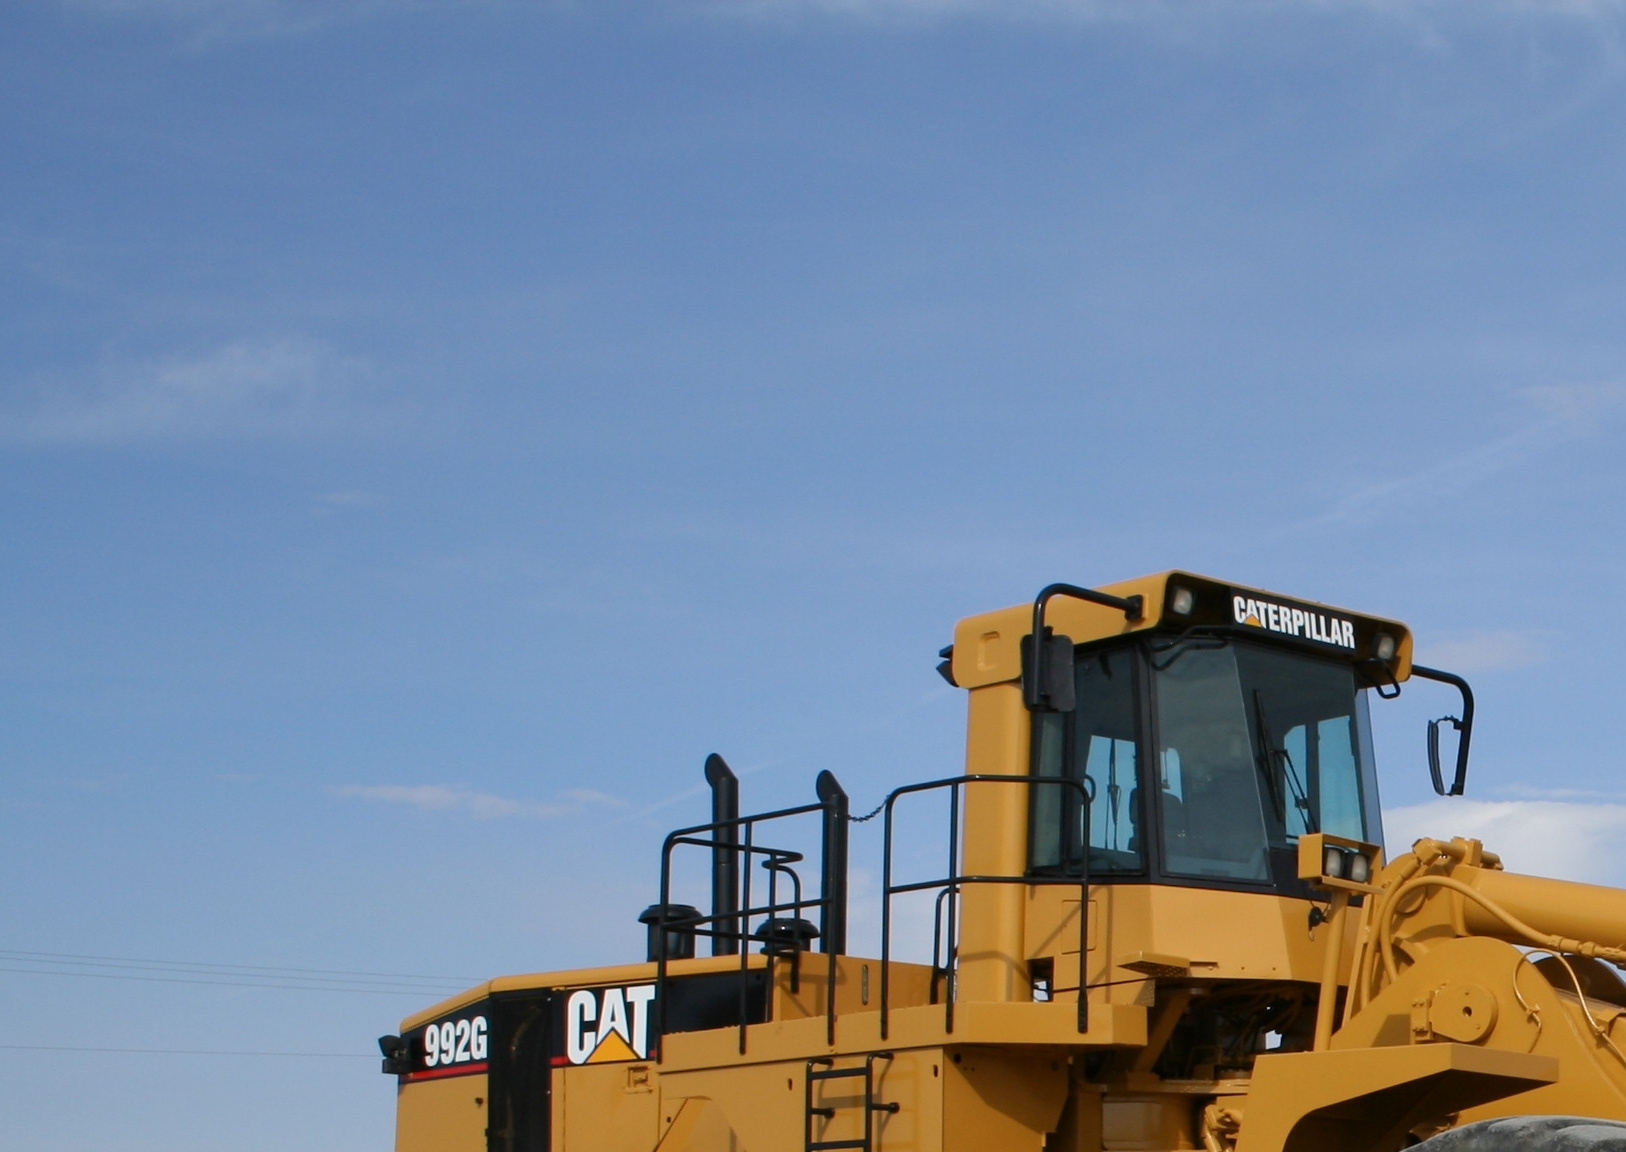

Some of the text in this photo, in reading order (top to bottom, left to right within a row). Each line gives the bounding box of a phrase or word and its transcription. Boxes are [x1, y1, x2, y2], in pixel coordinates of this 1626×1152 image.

[1233, 596, 1355, 649] CATERPILLAR
[425, 1016, 487, 1066] 992G
[567, 984, 655, 1064] CAT
